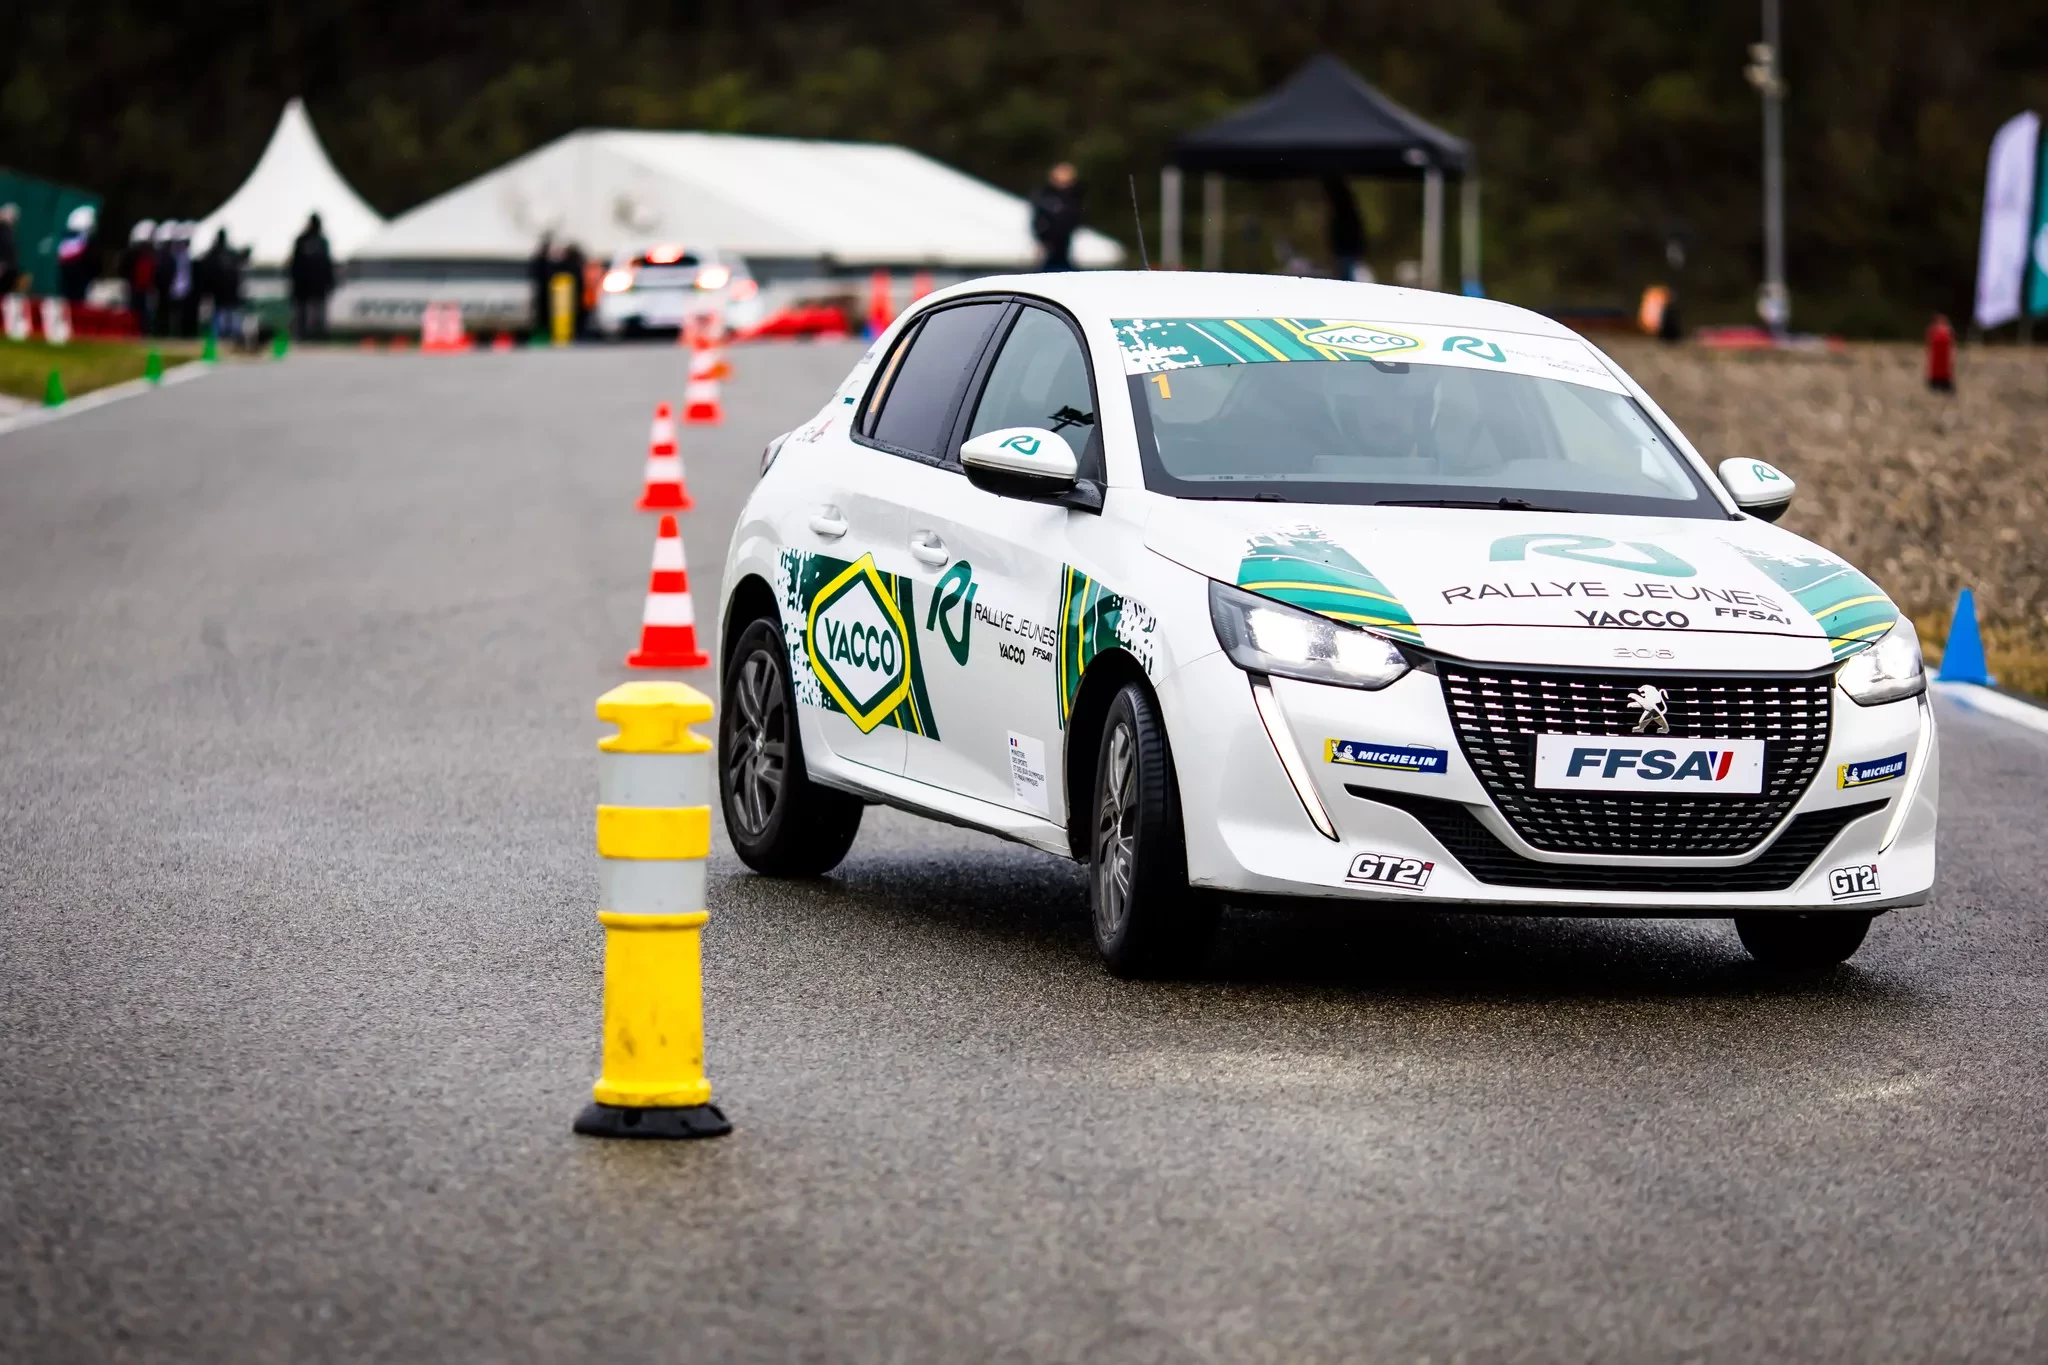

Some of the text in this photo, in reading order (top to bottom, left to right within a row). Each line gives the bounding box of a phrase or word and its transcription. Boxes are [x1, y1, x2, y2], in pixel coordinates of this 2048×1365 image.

[1318, 334, 1406, 346] YACCO
[1151, 373, 1172, 399] 1
[1441, 581, 1784, 612] RALLYE JEUNES
[974, 602, 1056, 647] RALLYE JEUNES
[1575, 607, 1786, 628] YACCO FFSA
[824, 617, 896, 677] YACCO
[999, 642, 1026, 666] YACCO
[1612, 647, 1676, 660] 208
[1357, 750, 1438, 767] MICHELIN
[1566, 747, 1713, 782] FFSA
[1861, 761, 1903, 779] MICHELIN
[1347, 852, 1436, 888] GT2i
[1829, 864, 1881, 896] GT2i
